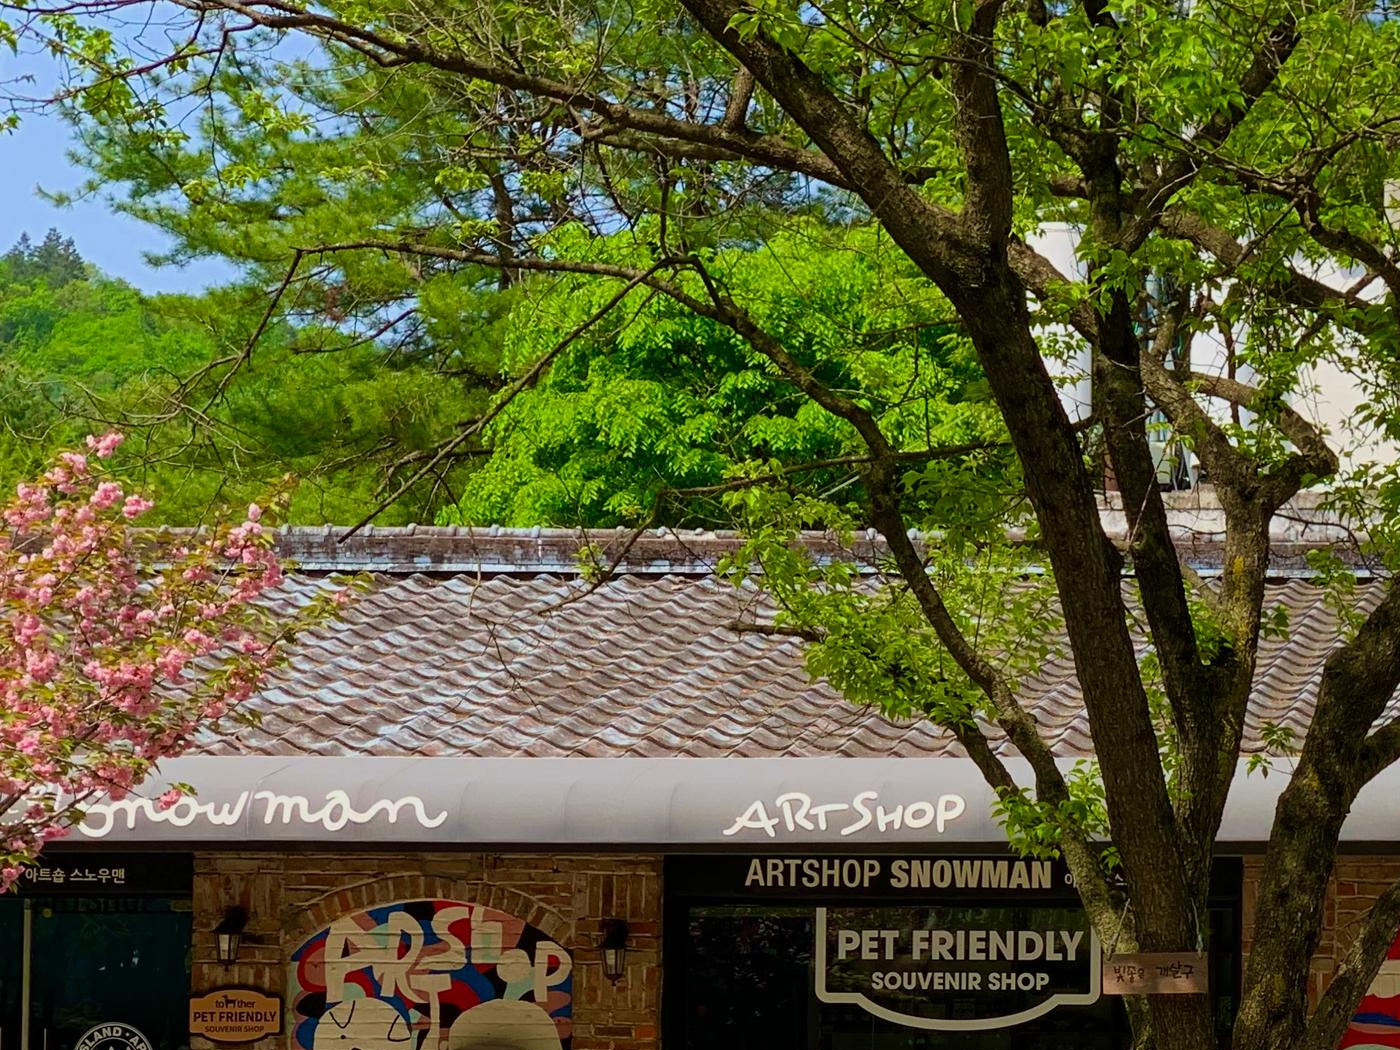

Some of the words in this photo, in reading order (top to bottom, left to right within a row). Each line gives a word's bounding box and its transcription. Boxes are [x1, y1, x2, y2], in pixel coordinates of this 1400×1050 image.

[25, 867, 66, 884] 아트숍
[69, 867, 126, 884] 스노우맨
[744, 858, 881, 889] ARTSHOP
[889, 859, 1052, 889] SNOWMAN
[837, 930, 902, 961] PET
[911, 930, 1084, 961] FRIENDLY
[1155, 960, 1194, 980] 개살구
[871, 972, 982, 992] SOUVENIR
[988, 972, 1050, 992] SHOP
[193, 1011, 216, 1022] PET
[219, 1011, 277, 1022] FRIENDLY
[204, 1025, 242, 1033] SOUVENIR
[244, 1025, 265, 1033] SHOP
